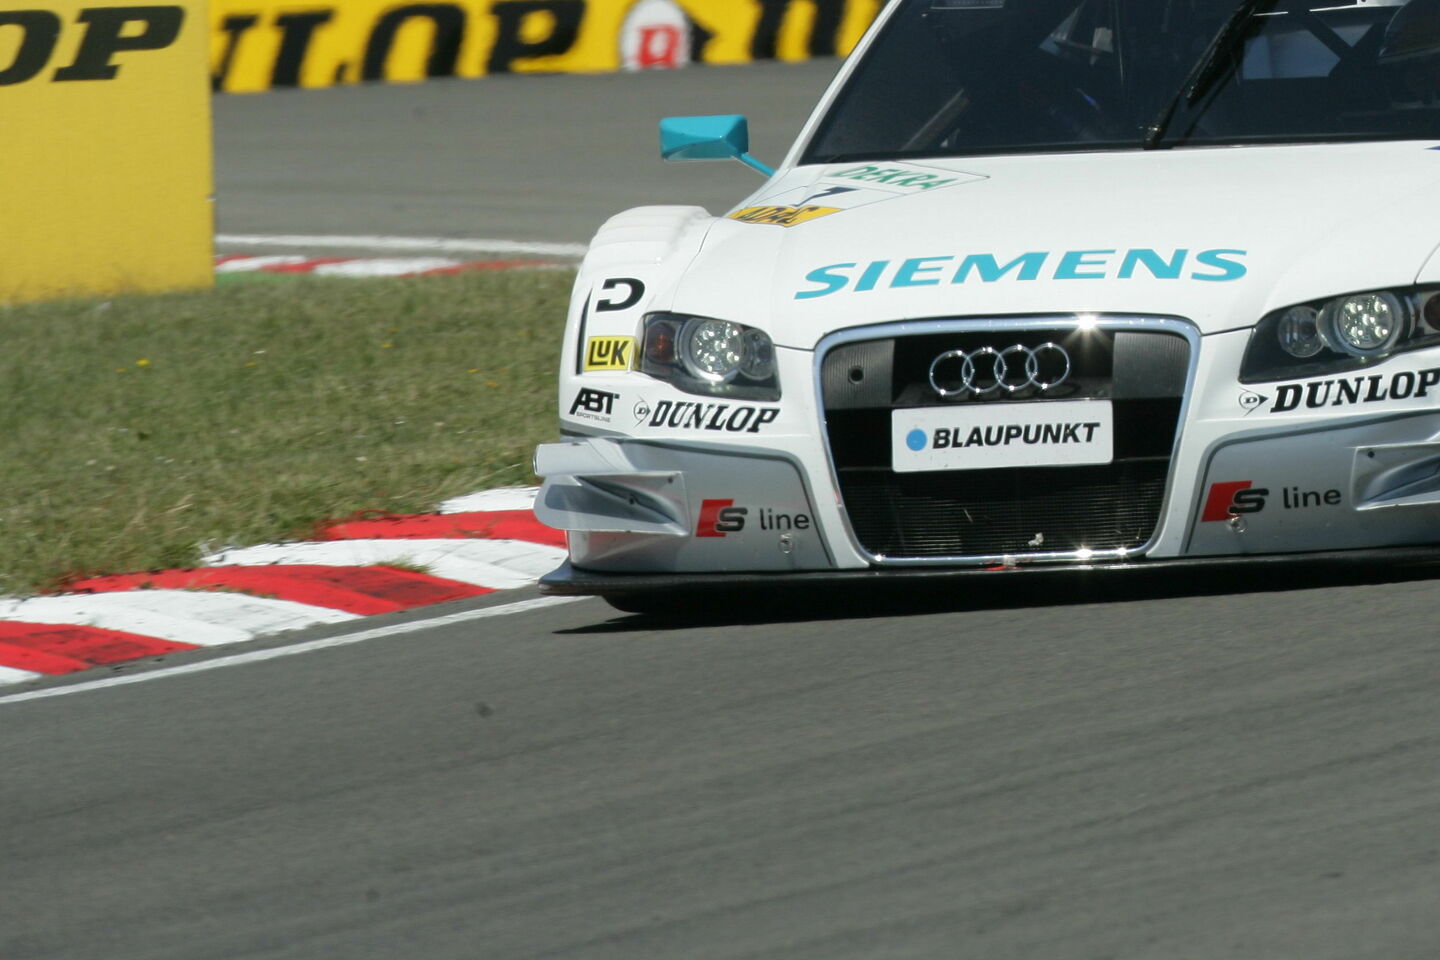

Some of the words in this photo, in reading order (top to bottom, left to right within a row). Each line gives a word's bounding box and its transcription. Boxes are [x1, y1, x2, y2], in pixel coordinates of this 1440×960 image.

[827, 166, 959, 190] DEKRA
[794, 248, 1247, 300] SIEMENS
[569, 387, 620, 415] ABT
[648, 400, 781, 433] DUNLOP
[932, 422, 1101, 449] BLAUPUNKT
[1283, 487, 1342, 509] line
[760, 508, 810, 530] line
